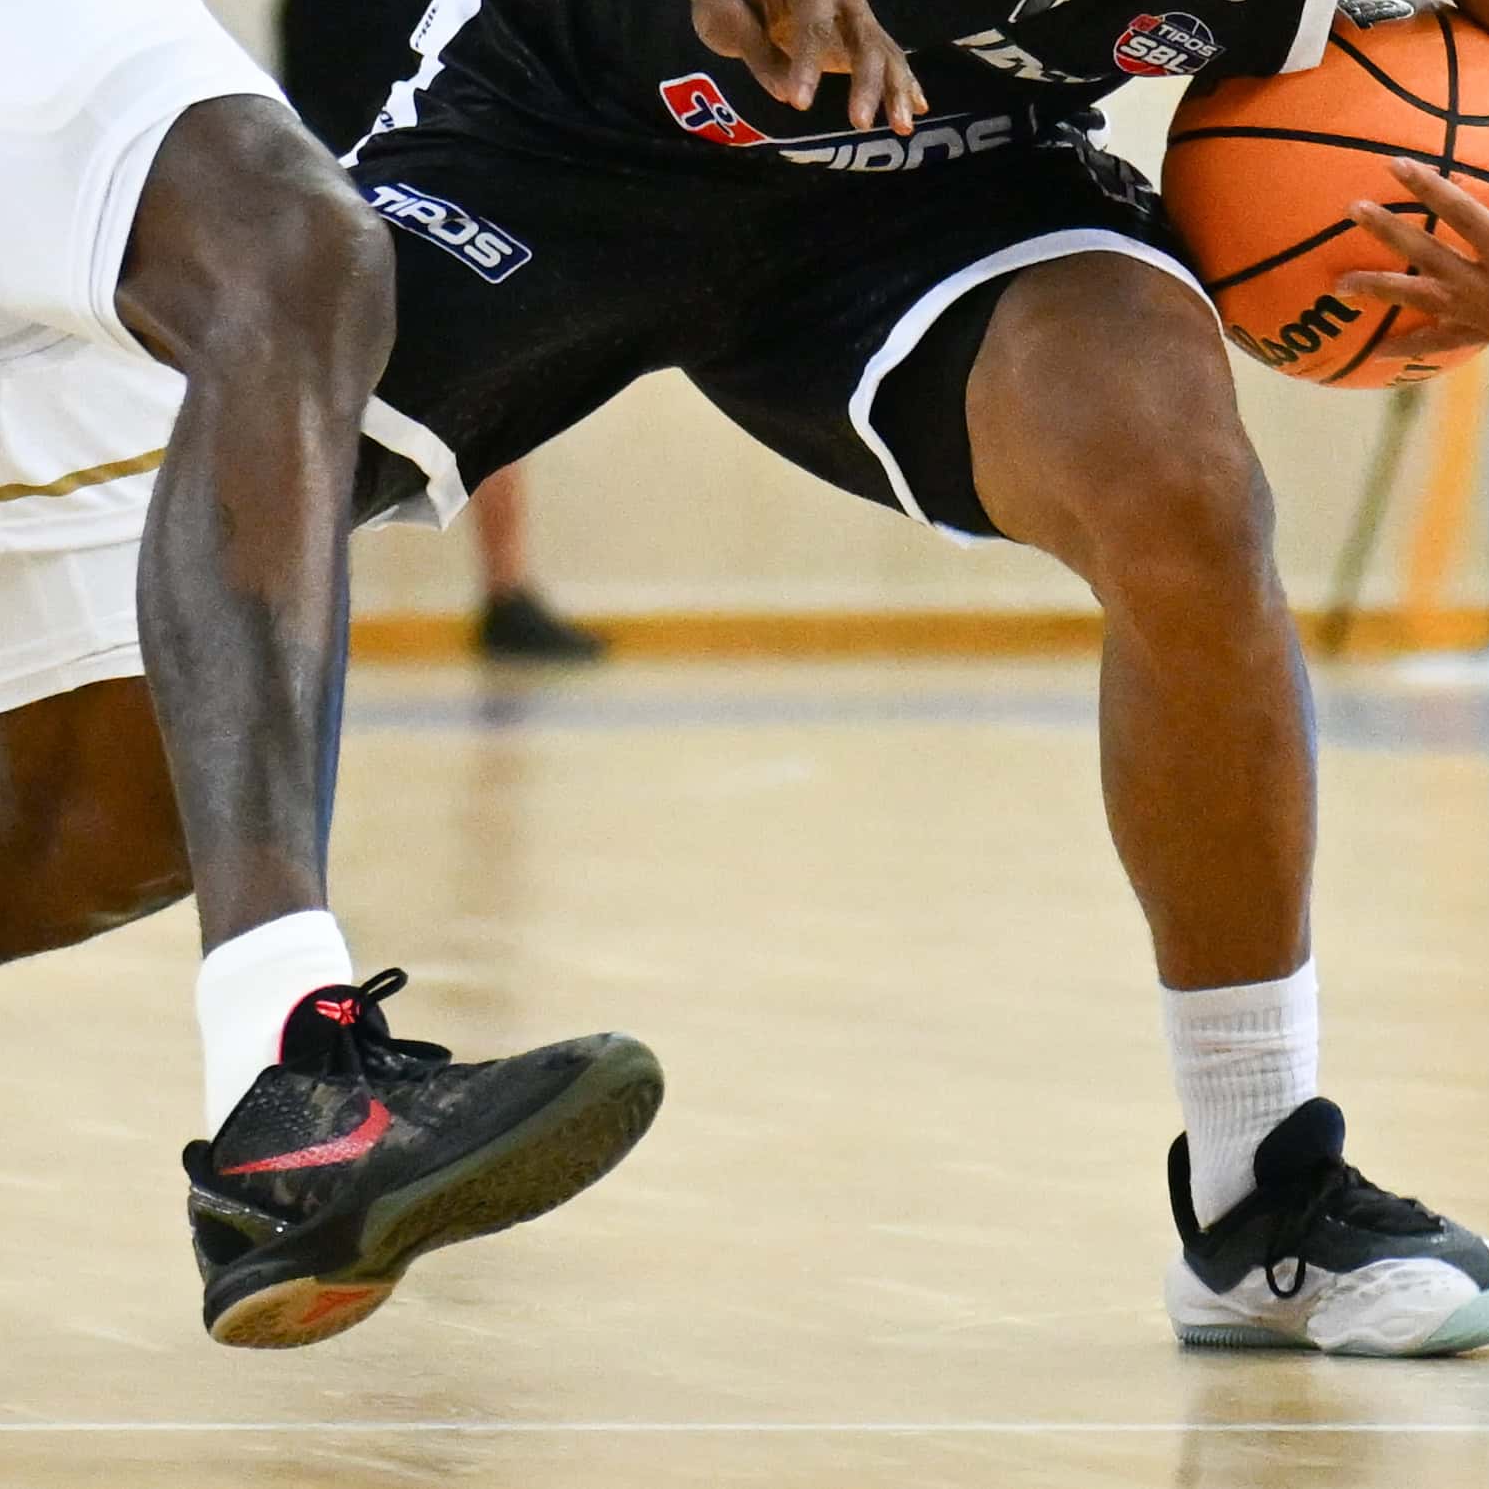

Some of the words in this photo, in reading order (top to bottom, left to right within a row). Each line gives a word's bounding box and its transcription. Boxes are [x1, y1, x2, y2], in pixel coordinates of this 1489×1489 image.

[1120, 35, 1189, 73] SBL
[1157, 24, 1218, 57] TIPOS
[371, 186, 513, 268] TIPOS
[1222, 294, 1362, 367] lson
